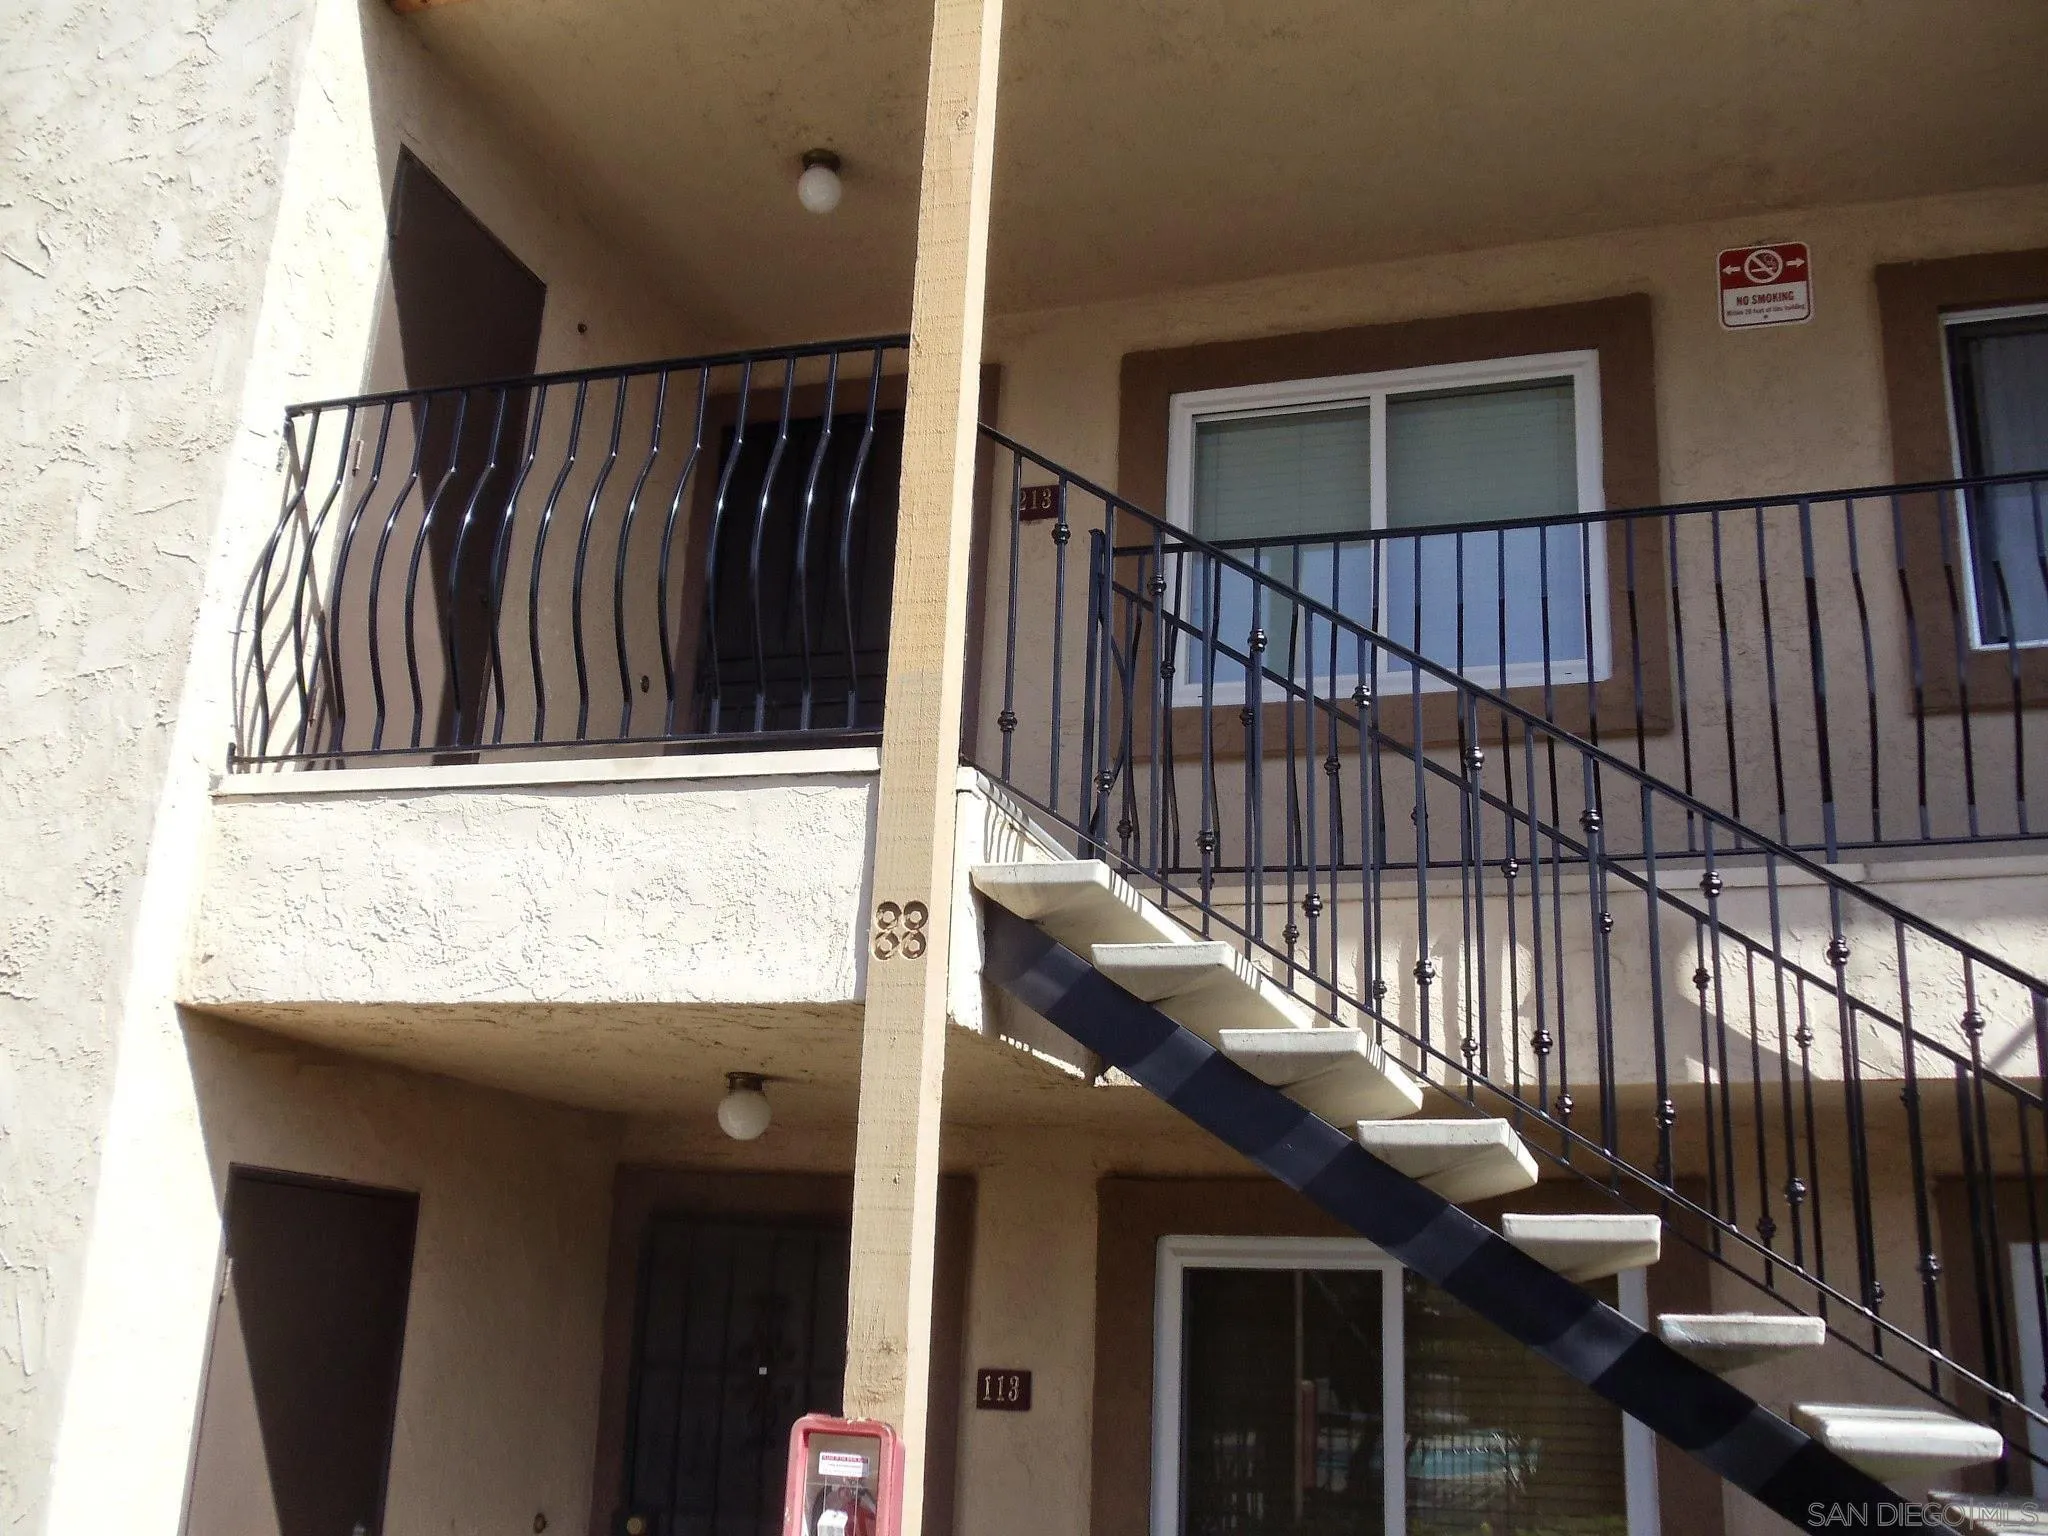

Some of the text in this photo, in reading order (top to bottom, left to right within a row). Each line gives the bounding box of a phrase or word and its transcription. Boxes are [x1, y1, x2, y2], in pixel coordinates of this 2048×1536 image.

[1736, 291, 1794, 306] NO SMOKING
[1019, 488, 1052, 511] 213
[982, 1375, 1020, 1402] 113
